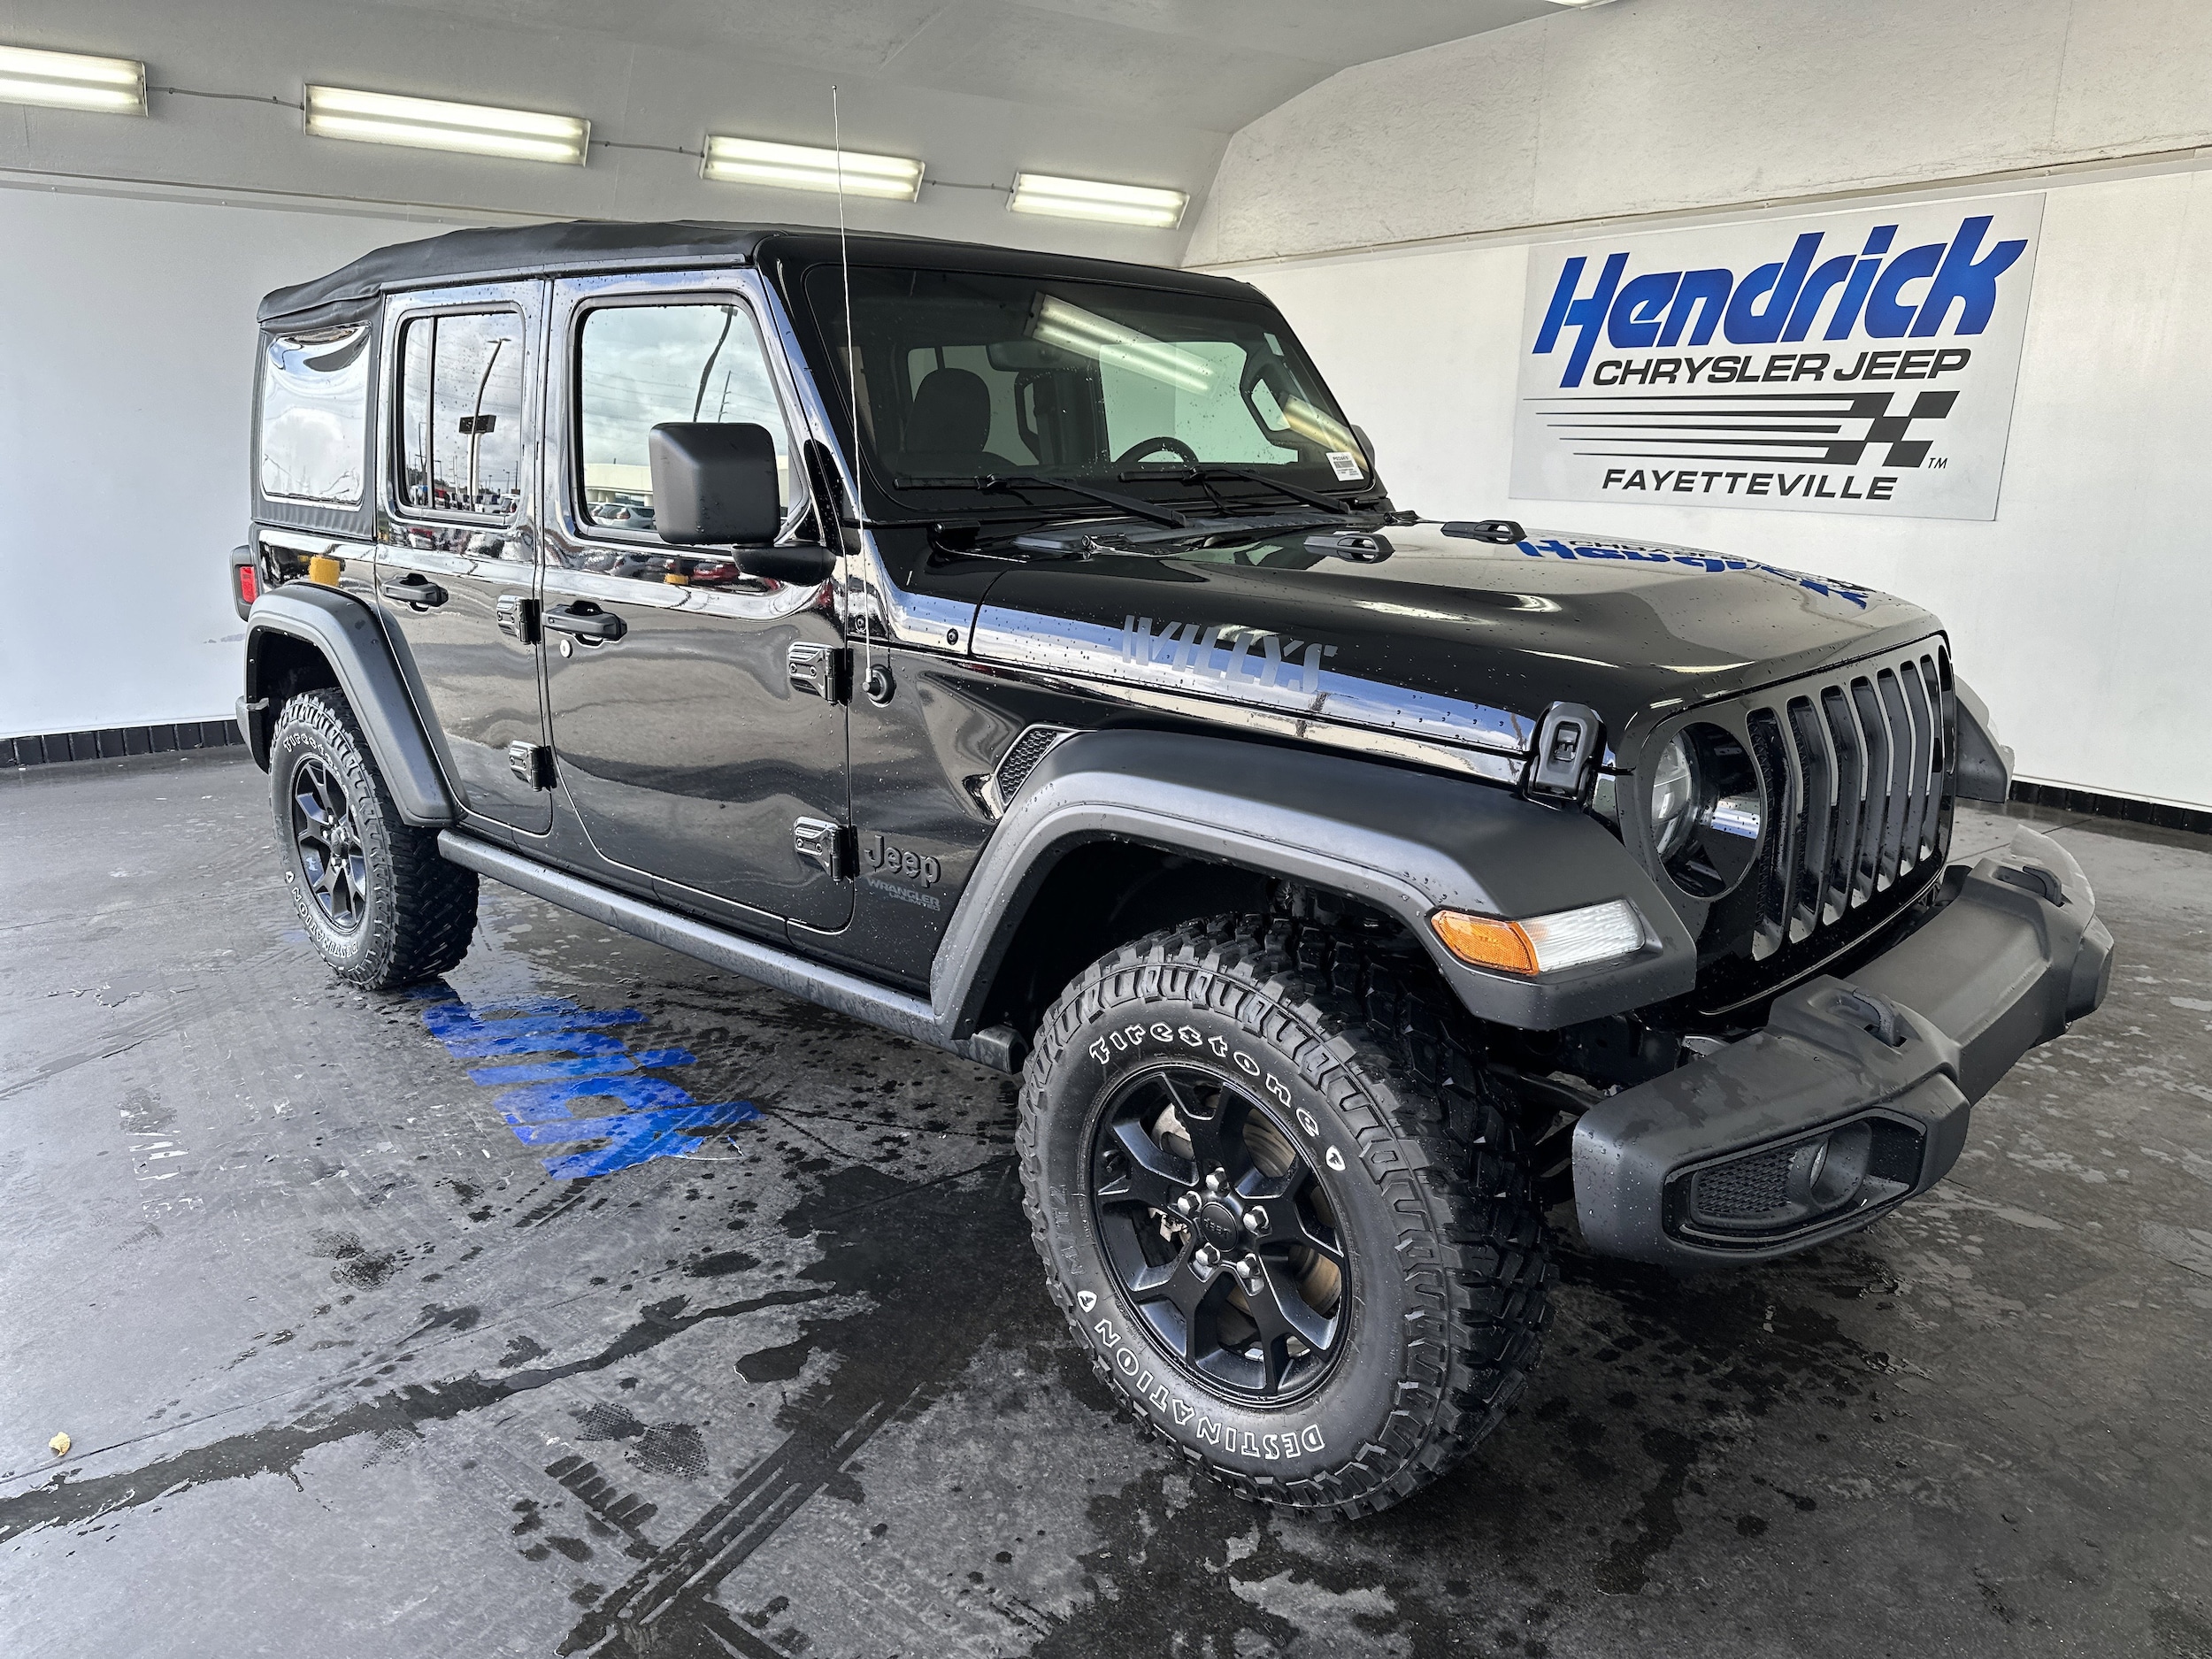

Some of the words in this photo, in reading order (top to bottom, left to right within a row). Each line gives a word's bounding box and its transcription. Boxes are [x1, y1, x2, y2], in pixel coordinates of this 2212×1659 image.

[1532, 215, 2029, 388] Hendrick
[1593, 353, 1831, 386] CHRYSLER
[1833, 348, 1971, 381] JEEP
[1601, 468, 1899, 501] FAYETTEVILLE
[1927, 457, 1948, 470] TM
[864, 834, 941, 888] Jeep
[867, 877, 940, 907] WRANGLER
[888, 892, 941, 911] UNLIMITED
[291, 887, 359, 959] DESTINATION
[1089, 1020, 1320, 1138] Firestone
[1094, 1317, 1326, 1461] DESTINATION
